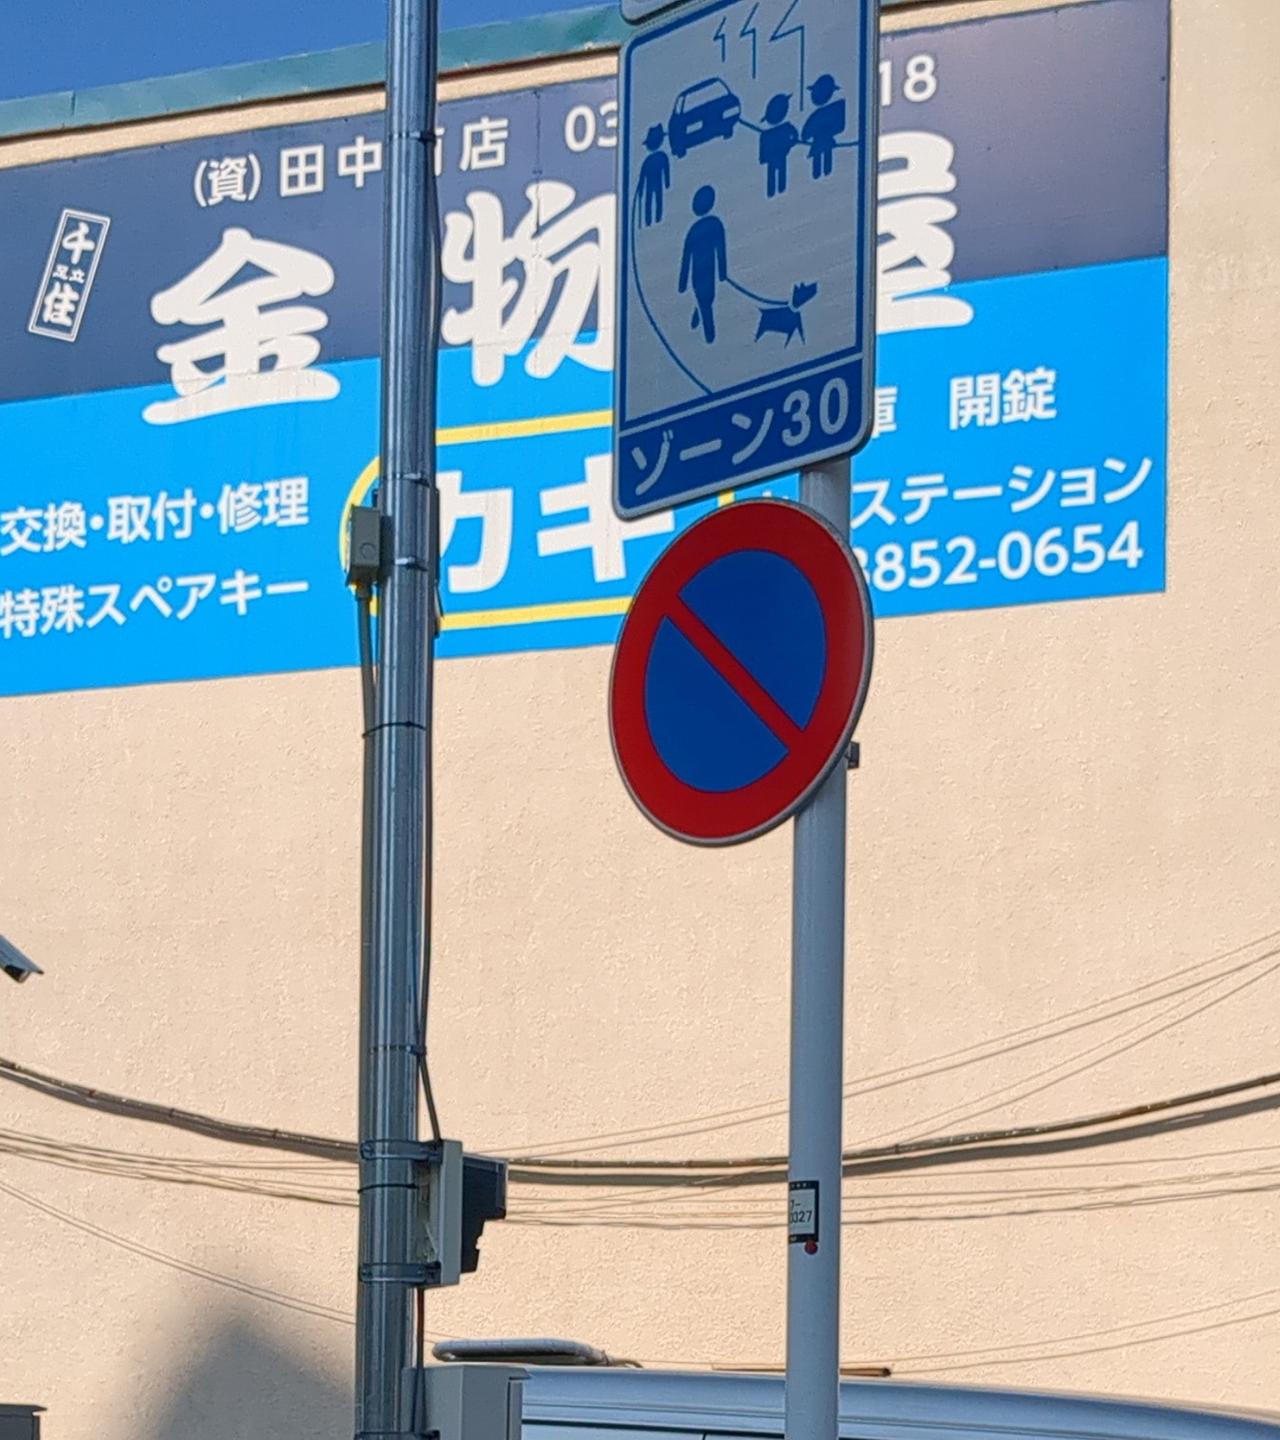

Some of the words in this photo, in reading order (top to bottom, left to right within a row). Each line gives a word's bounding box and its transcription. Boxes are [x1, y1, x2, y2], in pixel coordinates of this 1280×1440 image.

[631, 376, 851, 497] ゾーン30
[949, 365, 1058, 431] 開錠
